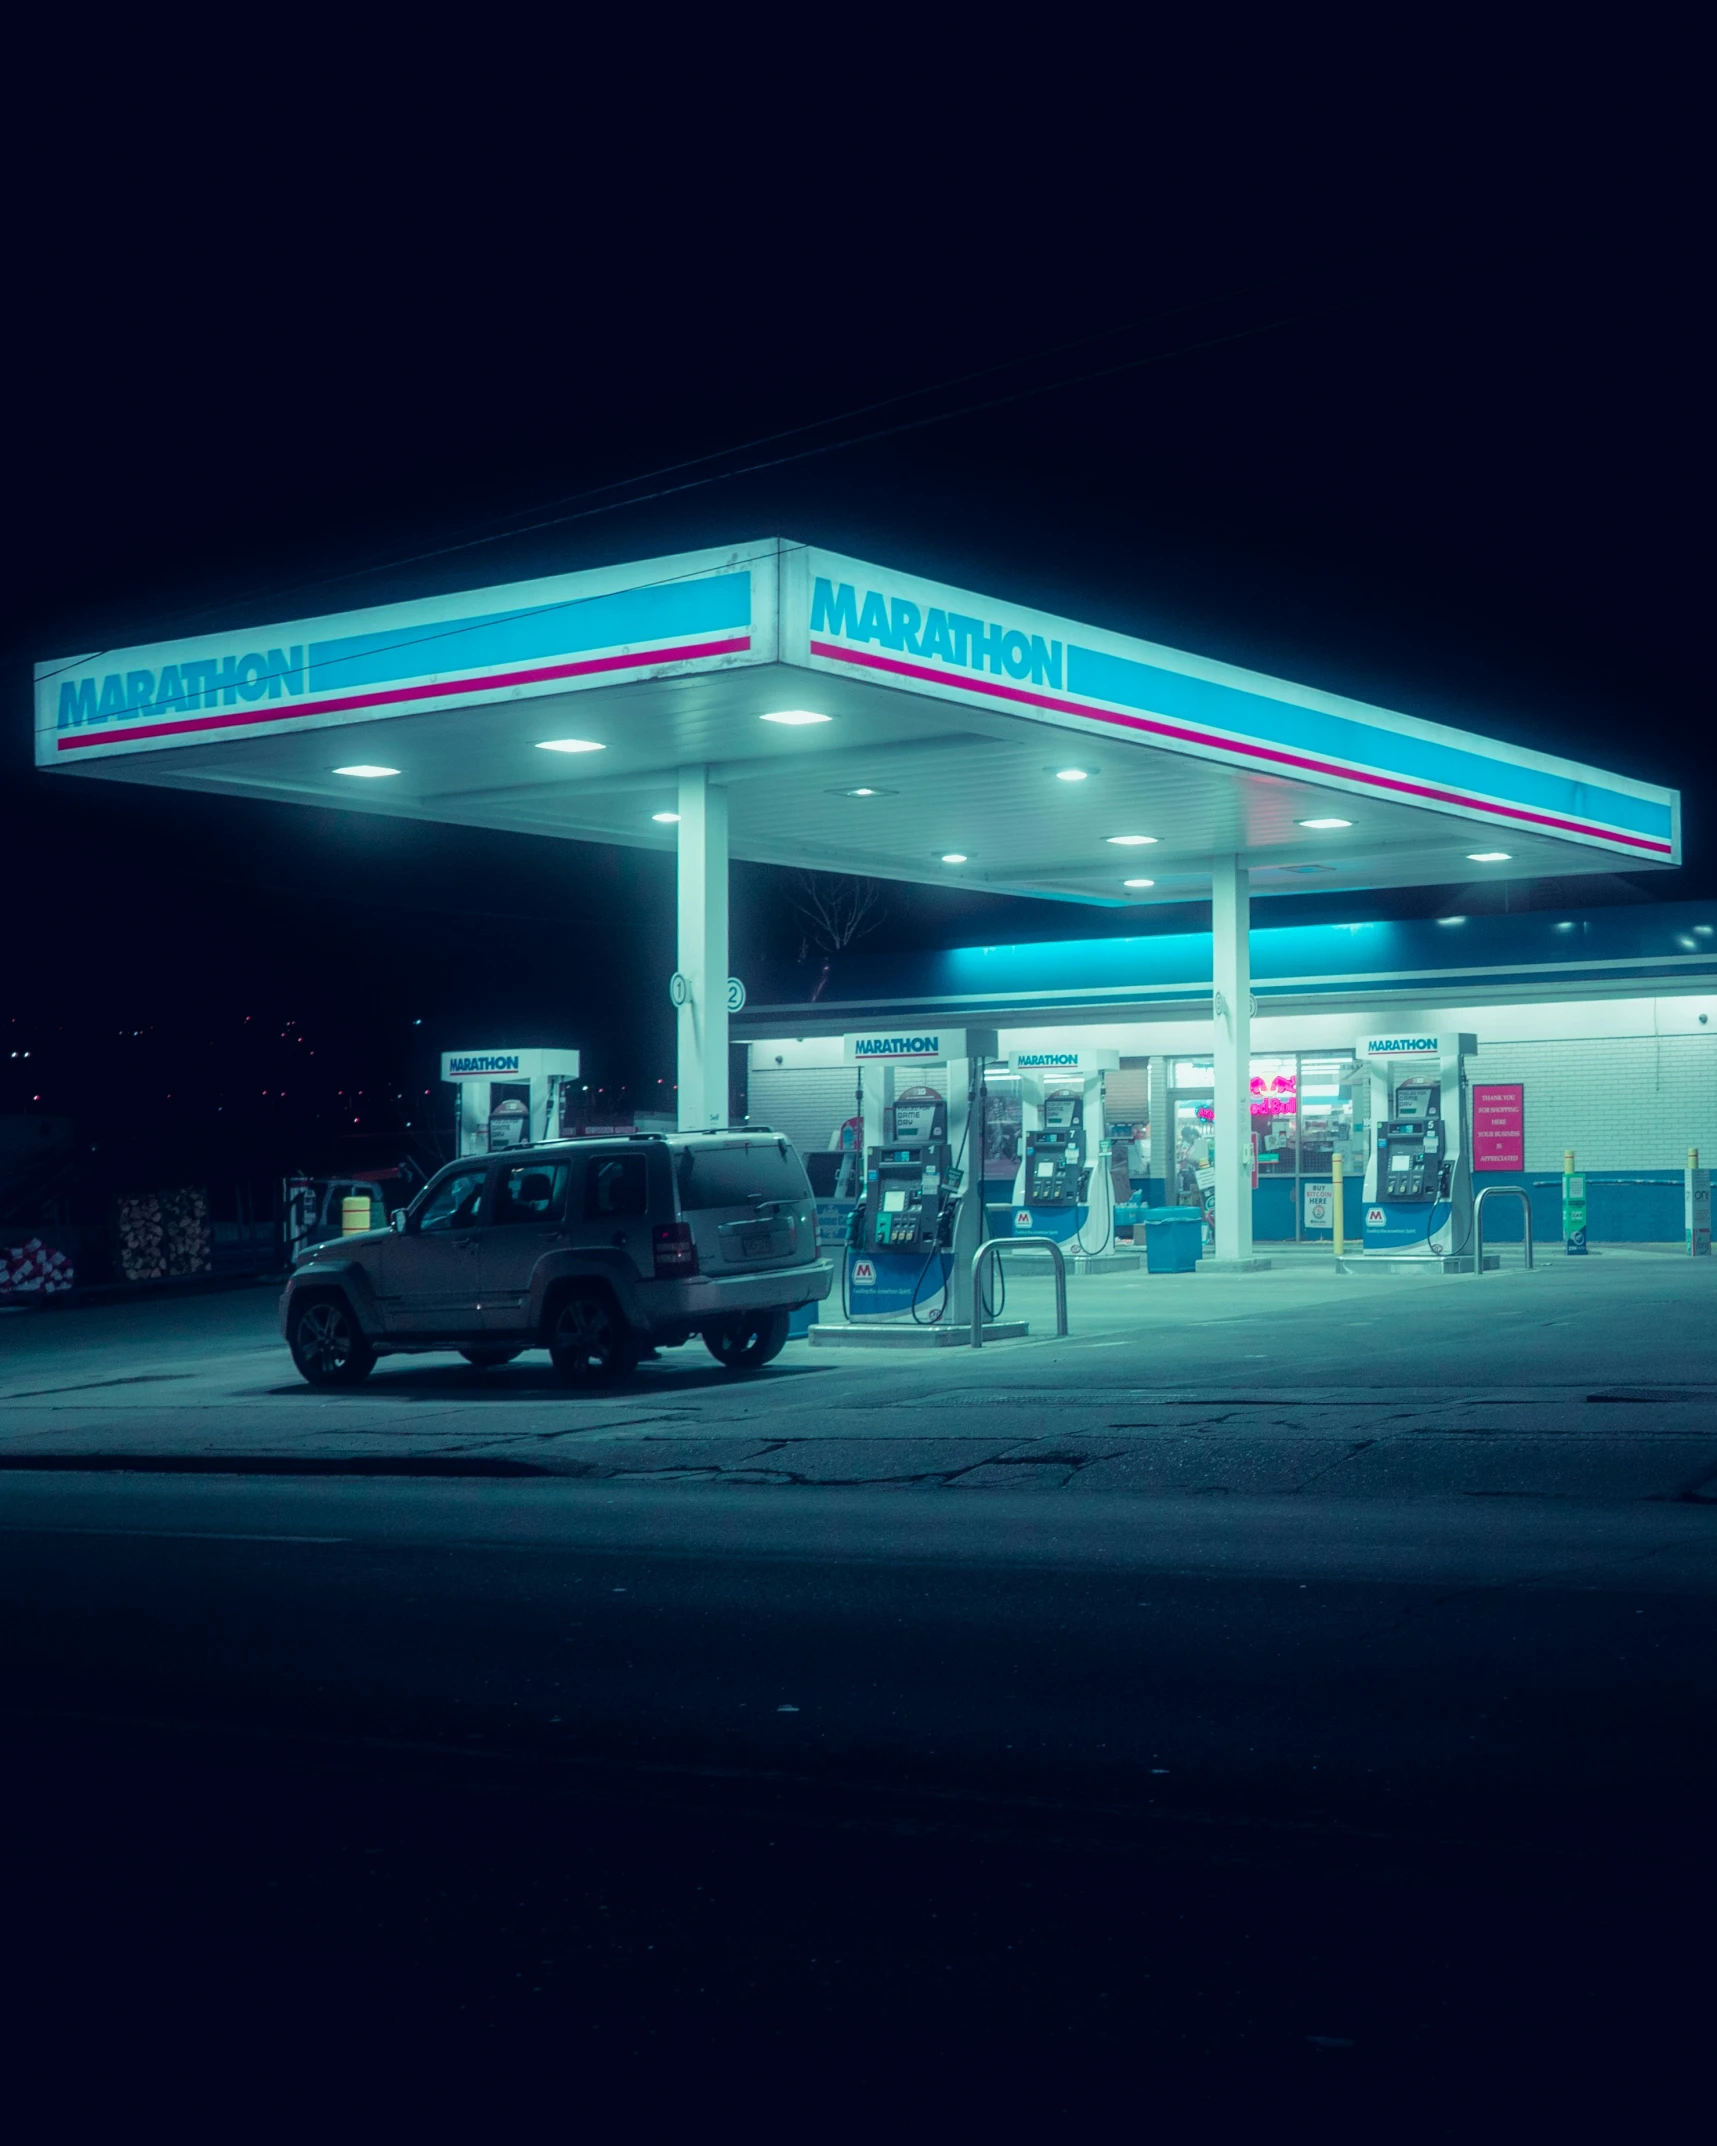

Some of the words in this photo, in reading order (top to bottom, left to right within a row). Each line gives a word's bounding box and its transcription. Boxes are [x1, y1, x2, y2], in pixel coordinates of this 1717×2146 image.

[810, 576, 1062, 690] MARATHON
[57, 645, 304, 730] MARATHON
[676, 981, 682, 998] 1
[728, 986, 738, 1003] 2
[855, 1037, 938, 1054] MARATHON
[1368, 1038, 1438, 1051] MARATHON
[450, 1055, 519, 1072] MARATHON
[1018, 1054, 1078, 1066] MARATHON
[1250, 1098, 1269, 1115] ed
[1271, 1097, 1297, 1115] Bull
[1427, 1120, 1434, 1129] 5
[1070, 1130, 1076, 1138] 7
[928, 1145, 935, 1154] 1
[1018, 1213, 1029, 1222] M
[1370, 1211, 1382, 1220] M
[856, 1264, 872, 1276] M
